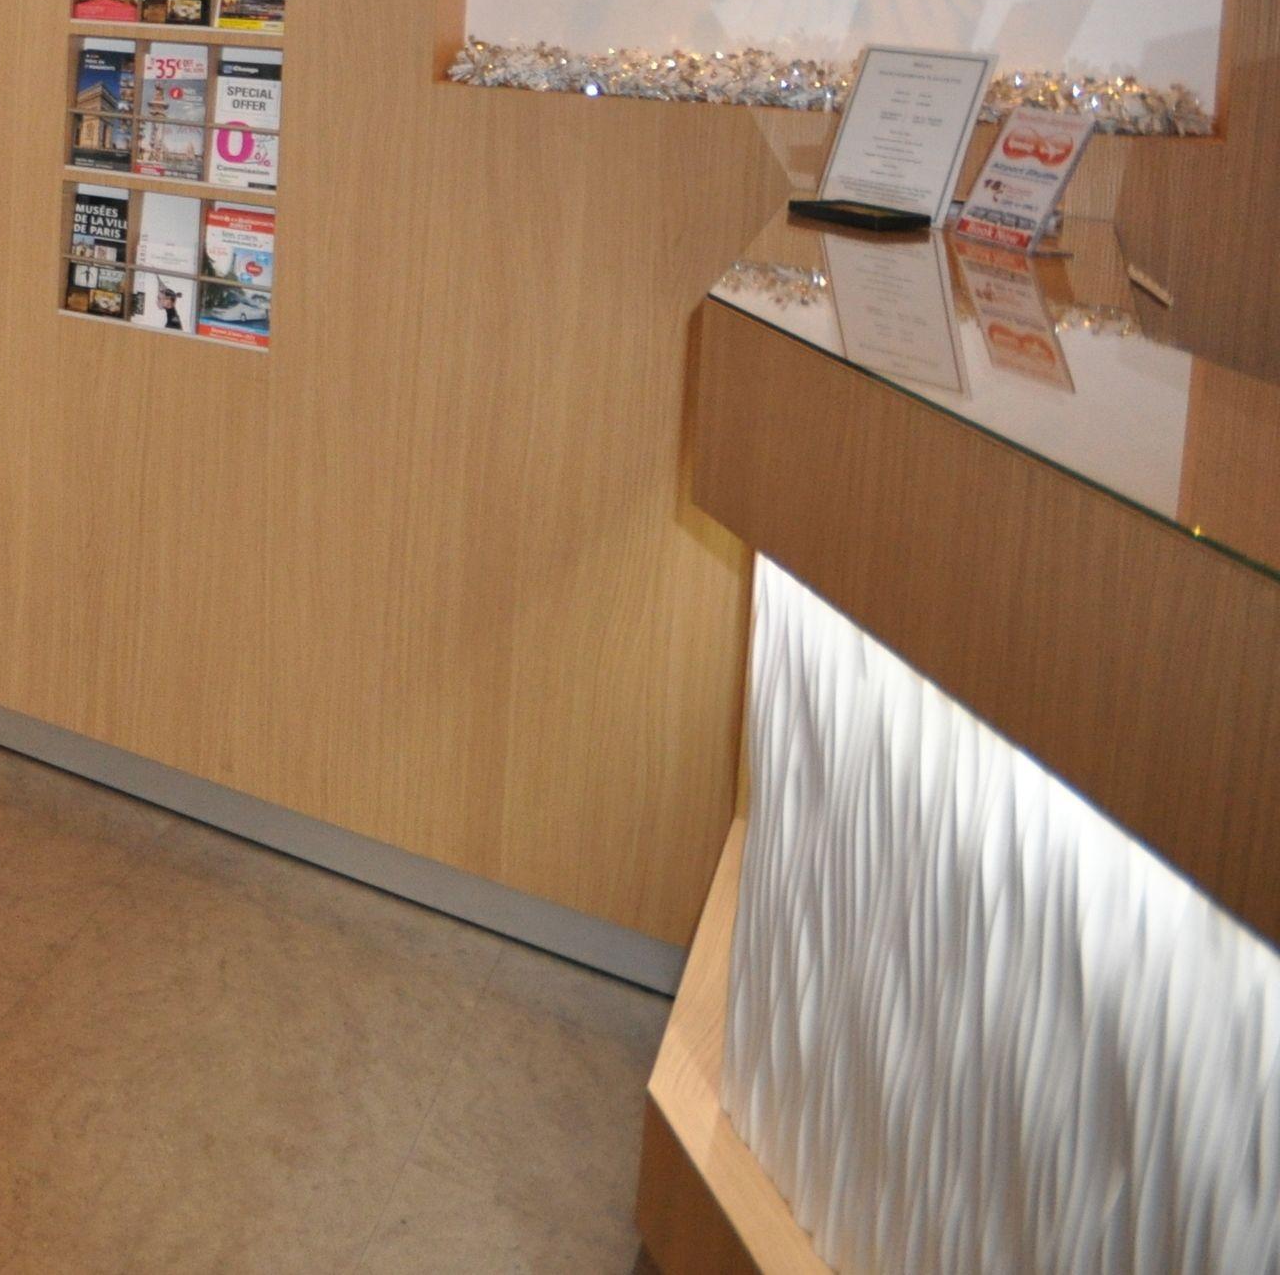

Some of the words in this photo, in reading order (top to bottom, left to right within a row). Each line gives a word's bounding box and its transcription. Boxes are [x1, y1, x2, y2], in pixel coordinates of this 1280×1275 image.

[226, 86, 274, 100] SPECIAL
[232, 99, 267, 112] OFFER
[75, 204, 119, 218] MUSÉES
[74, 213, 88, 224] DE
[91, 216, 104, 226] LA
[73, 223, 87, 234] DE
[89, 226, 121, 239] PARIS
